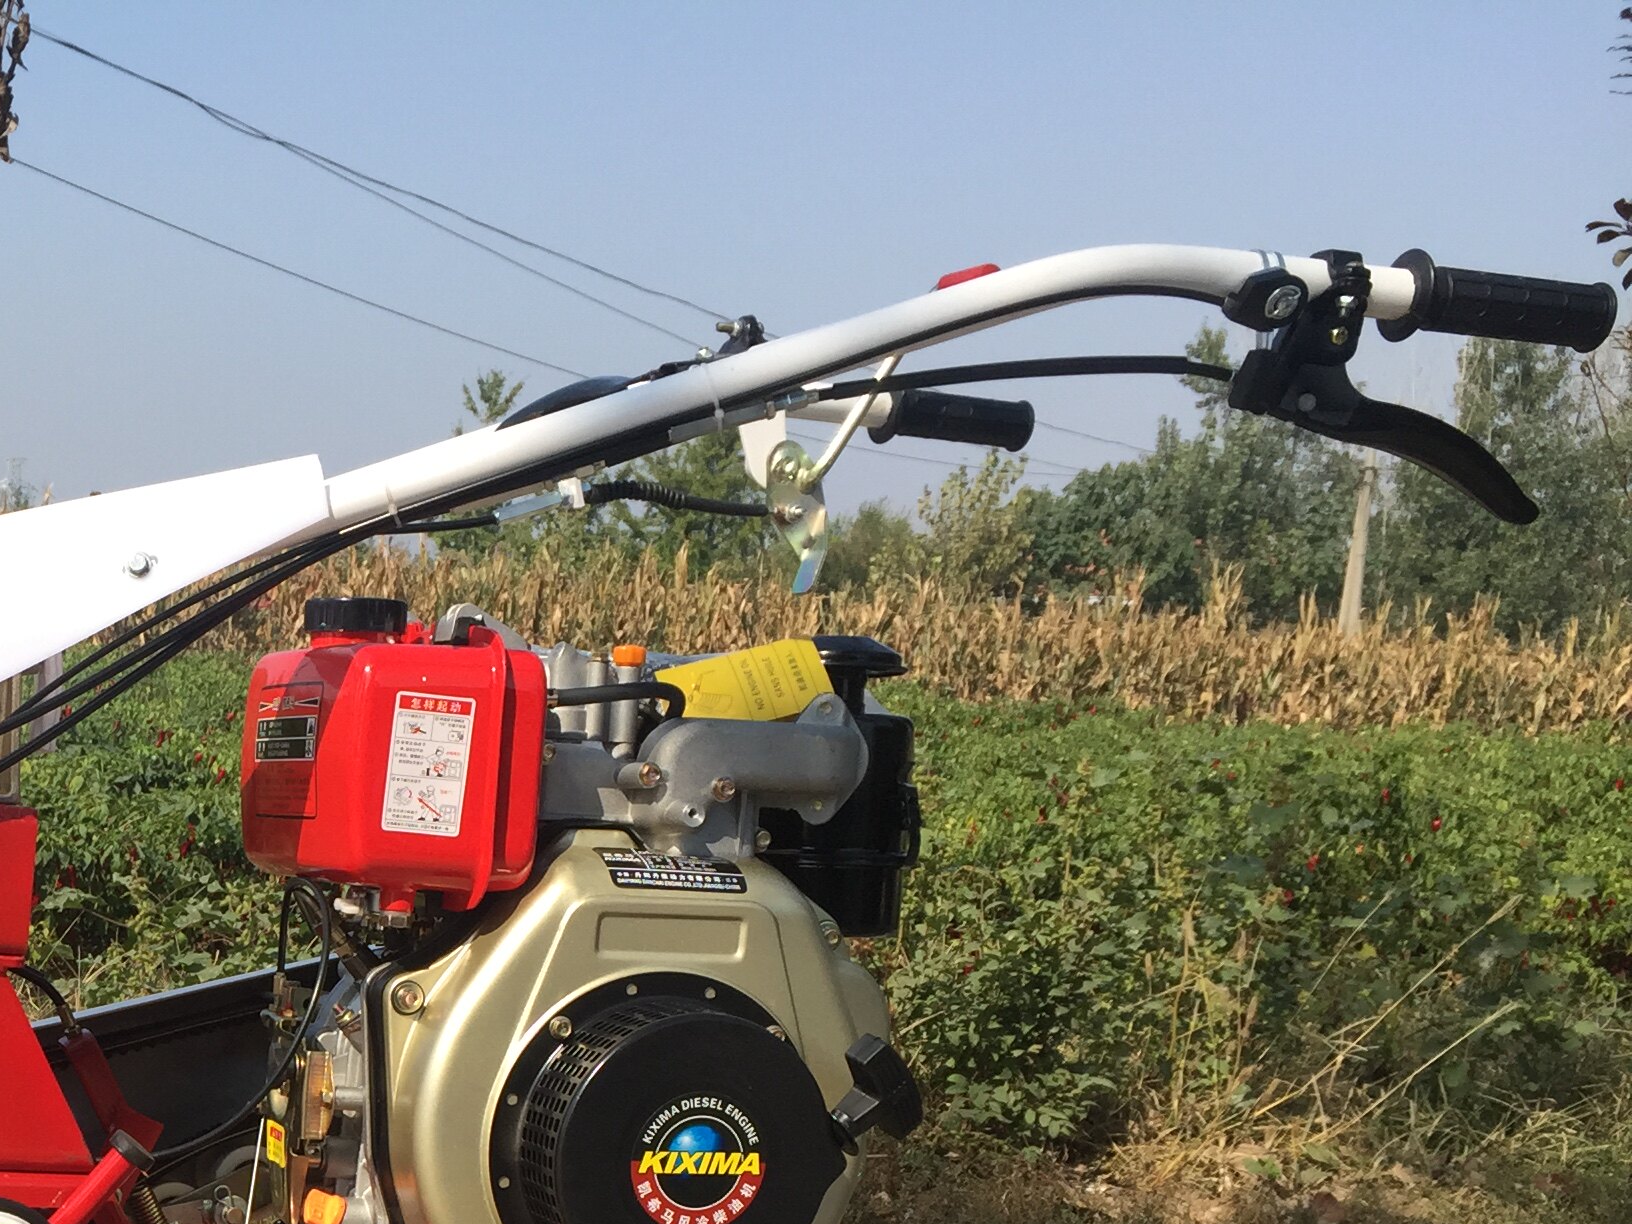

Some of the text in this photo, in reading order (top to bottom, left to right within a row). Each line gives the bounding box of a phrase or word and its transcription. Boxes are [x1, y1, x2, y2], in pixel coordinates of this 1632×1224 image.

[410, 697, 462, 713] 怎样起动
[641, 1096, 759, 1147] KIXIMA DIESEL ENGINE
[638, 1150, 761, 1175] KIXIMA
